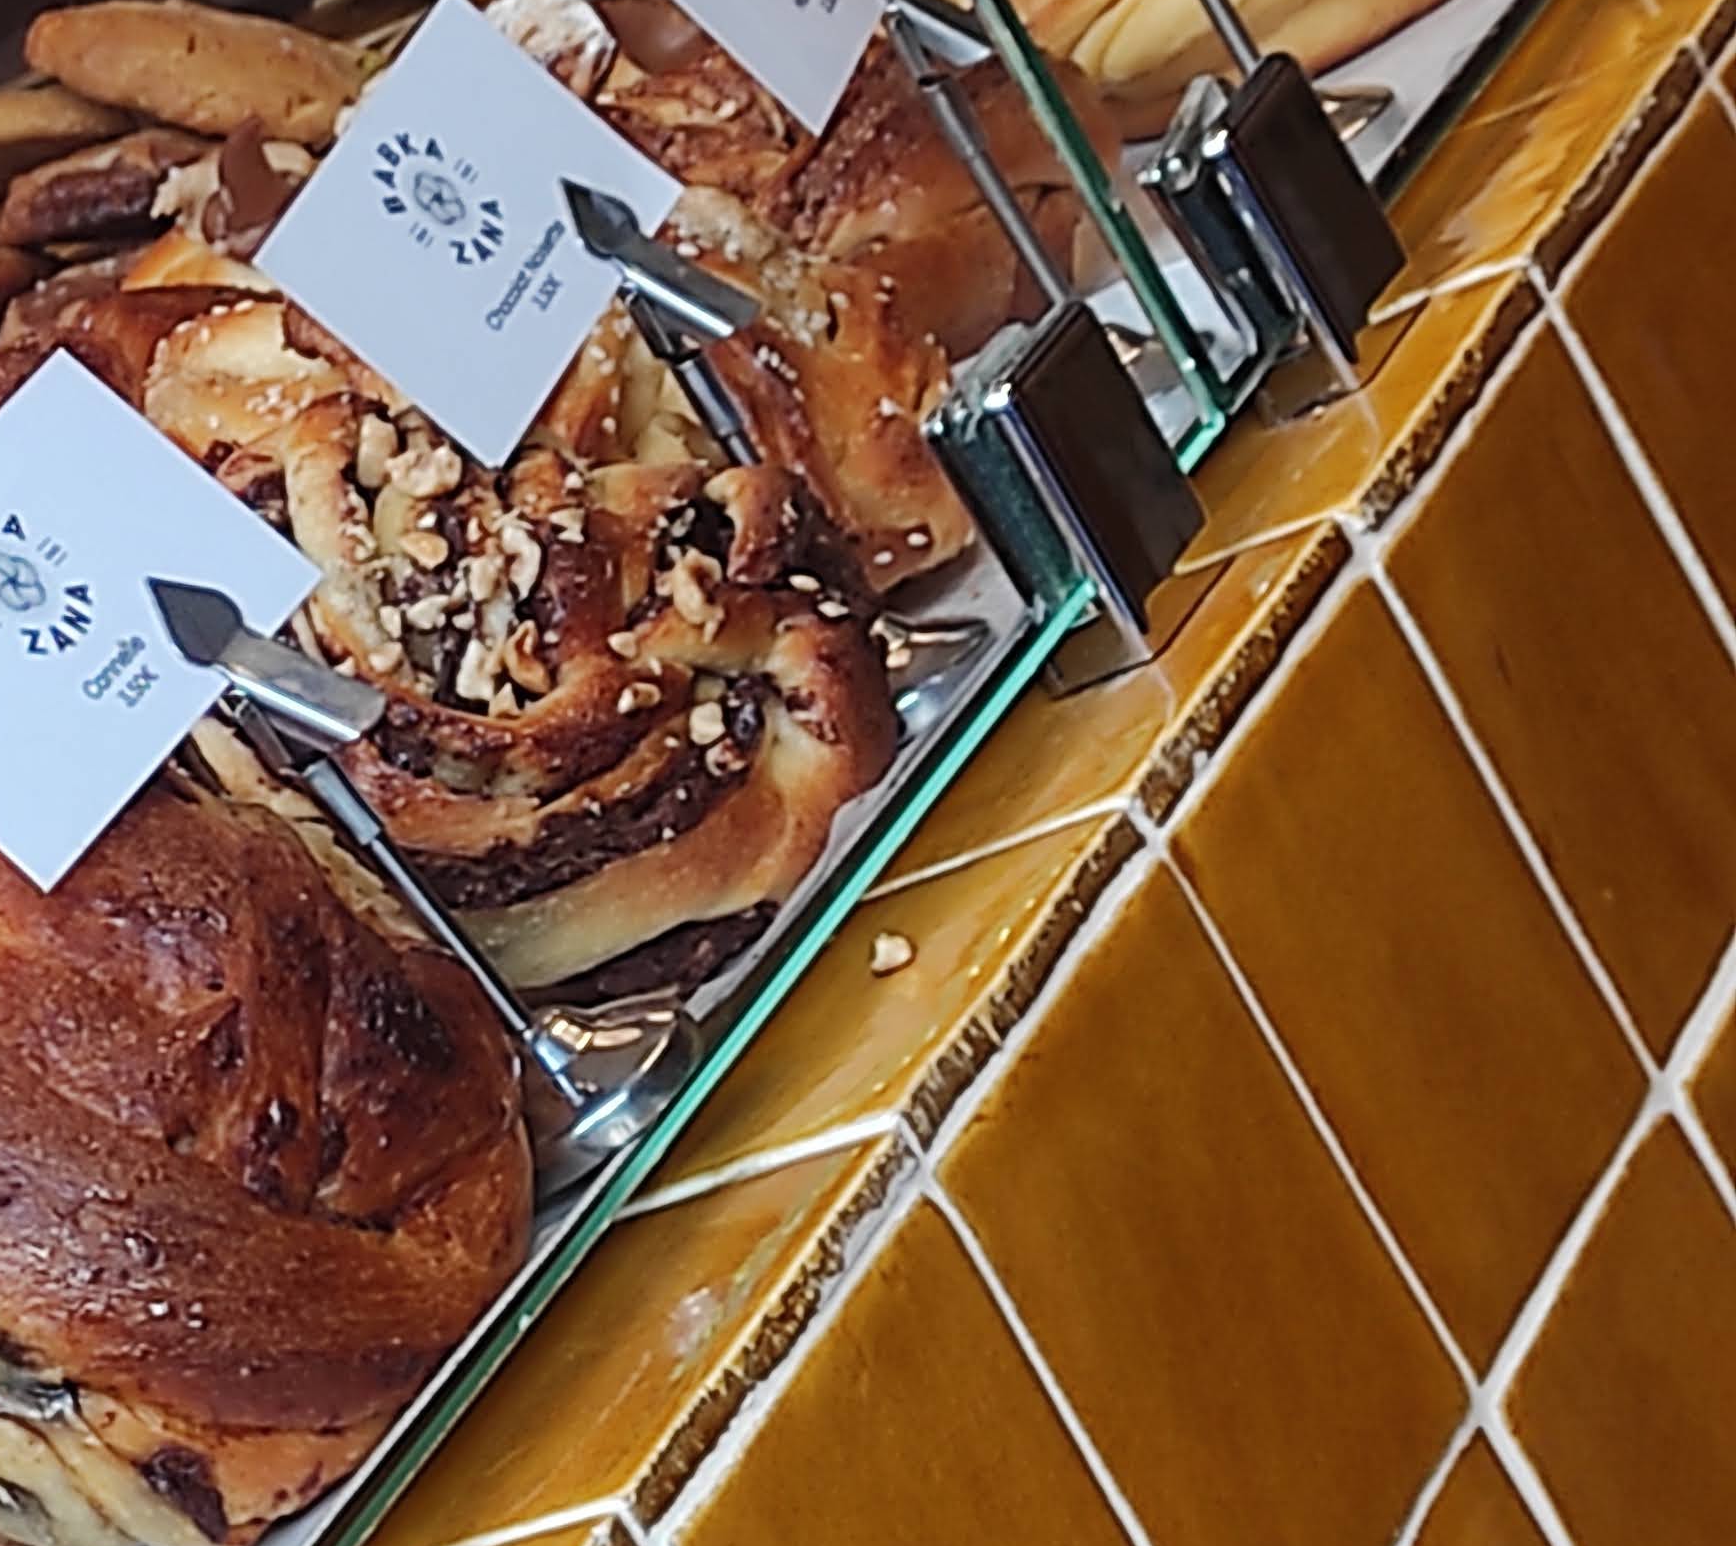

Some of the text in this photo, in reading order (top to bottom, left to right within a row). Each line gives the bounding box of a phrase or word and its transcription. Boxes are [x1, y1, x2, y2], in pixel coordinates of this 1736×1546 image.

[373, 133, 504, 266] BABKA ZANA
[19, 583, 94, 655] ZANA
[82, 635, 147, 702] Cannelle
